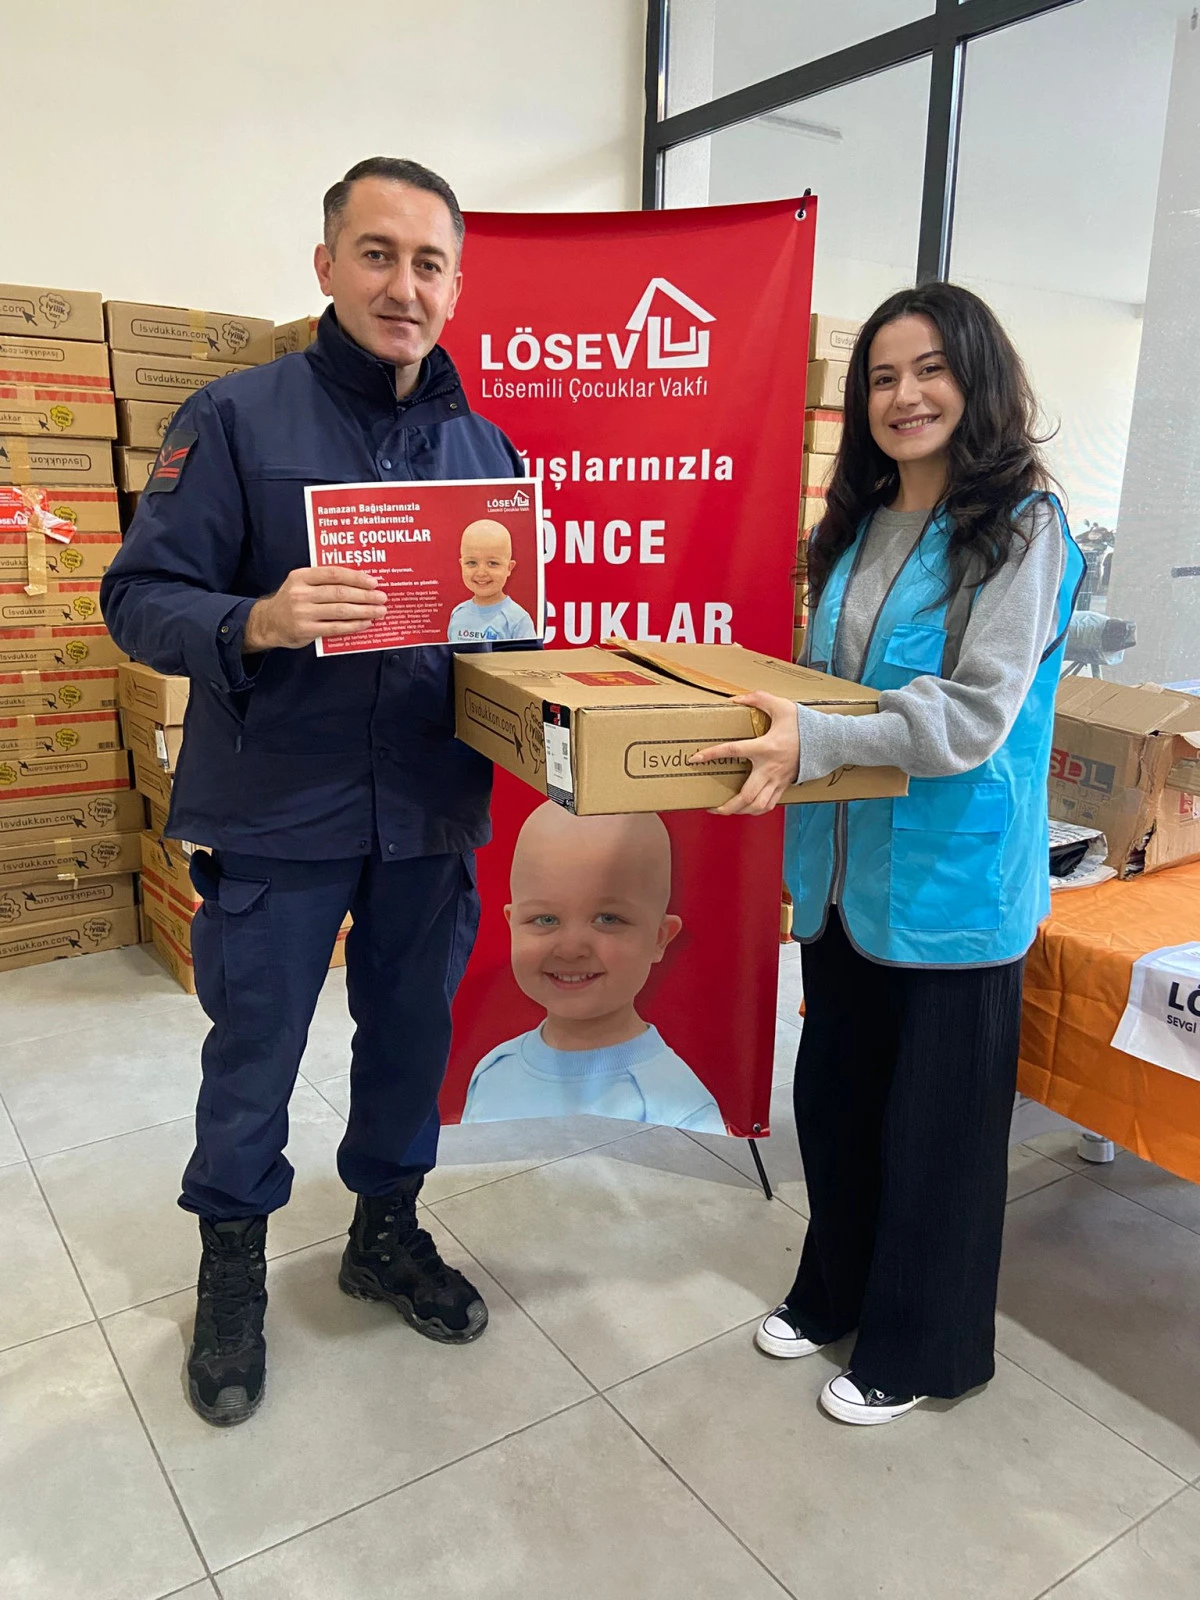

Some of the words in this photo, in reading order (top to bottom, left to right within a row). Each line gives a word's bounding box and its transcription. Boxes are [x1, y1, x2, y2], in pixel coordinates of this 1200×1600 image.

[481, 327, 640, 371] LÖSEV
[481, 379, 563, 399] Lösemili
[568, 377, 656, 403] Çocuklar
[660, 375, 708, 397] Vakfı
[317, 505, 357, 515] Ramazan
[358, 502, 421, 514] Bağışlarınızla
[318, 518, 338, 527] Fitre
[340, 518, 351, 526] ve
[353, 515, 414, 525] Zekatlarınızla
[320, 530, 355, 546] ÖNCE
[359, 528, 431, 548] ÇOCUKLAR
[321, 547, 387, 567] İYİLEŞSİN
